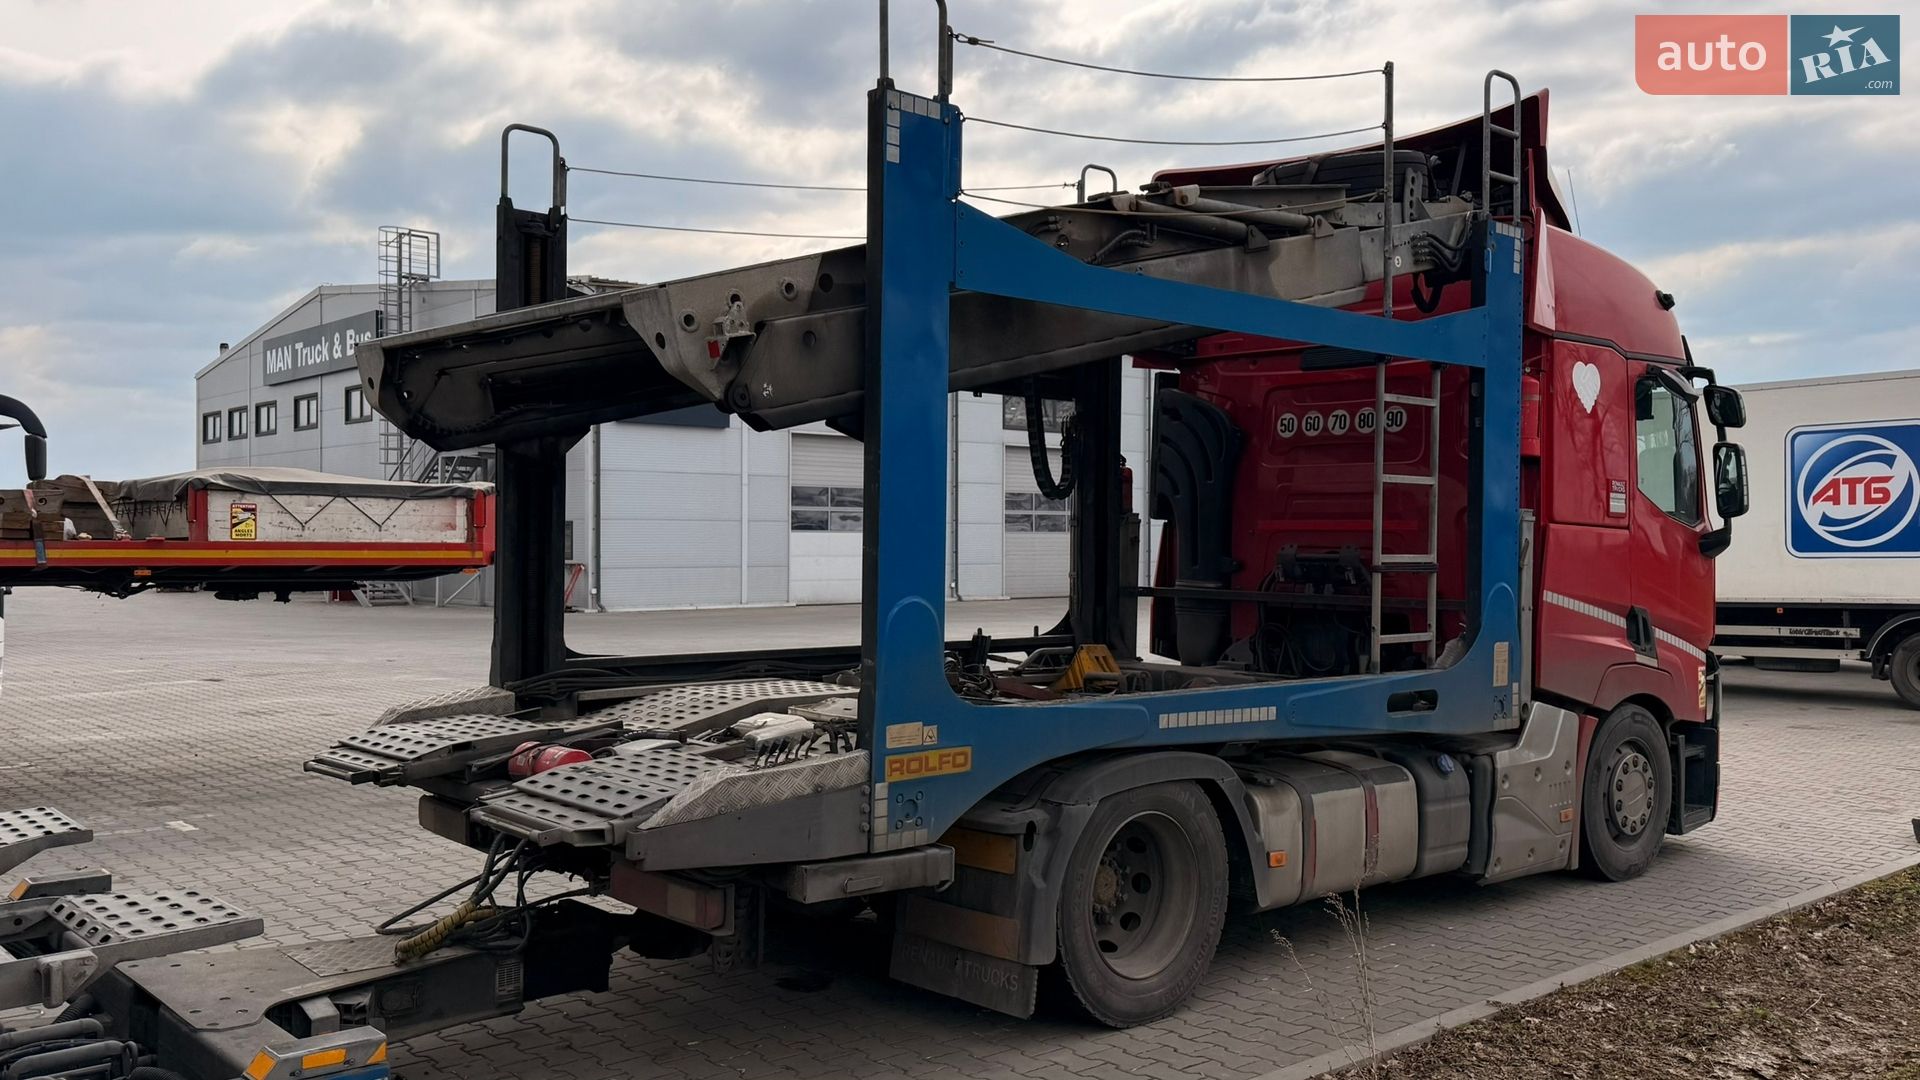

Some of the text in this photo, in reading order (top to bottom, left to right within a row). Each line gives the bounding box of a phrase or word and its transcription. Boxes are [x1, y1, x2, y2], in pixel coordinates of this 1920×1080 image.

[266, 344, 292, 375] MAN
[295, 336, 329, 367] Truck
[332, 332, 342, 360] &
[1280, 410, 1403, 433] 50 60 70 80 90
[888, 750, 969, 777] ROLFO
[964, 960, 1018, 992] TRUCKS
